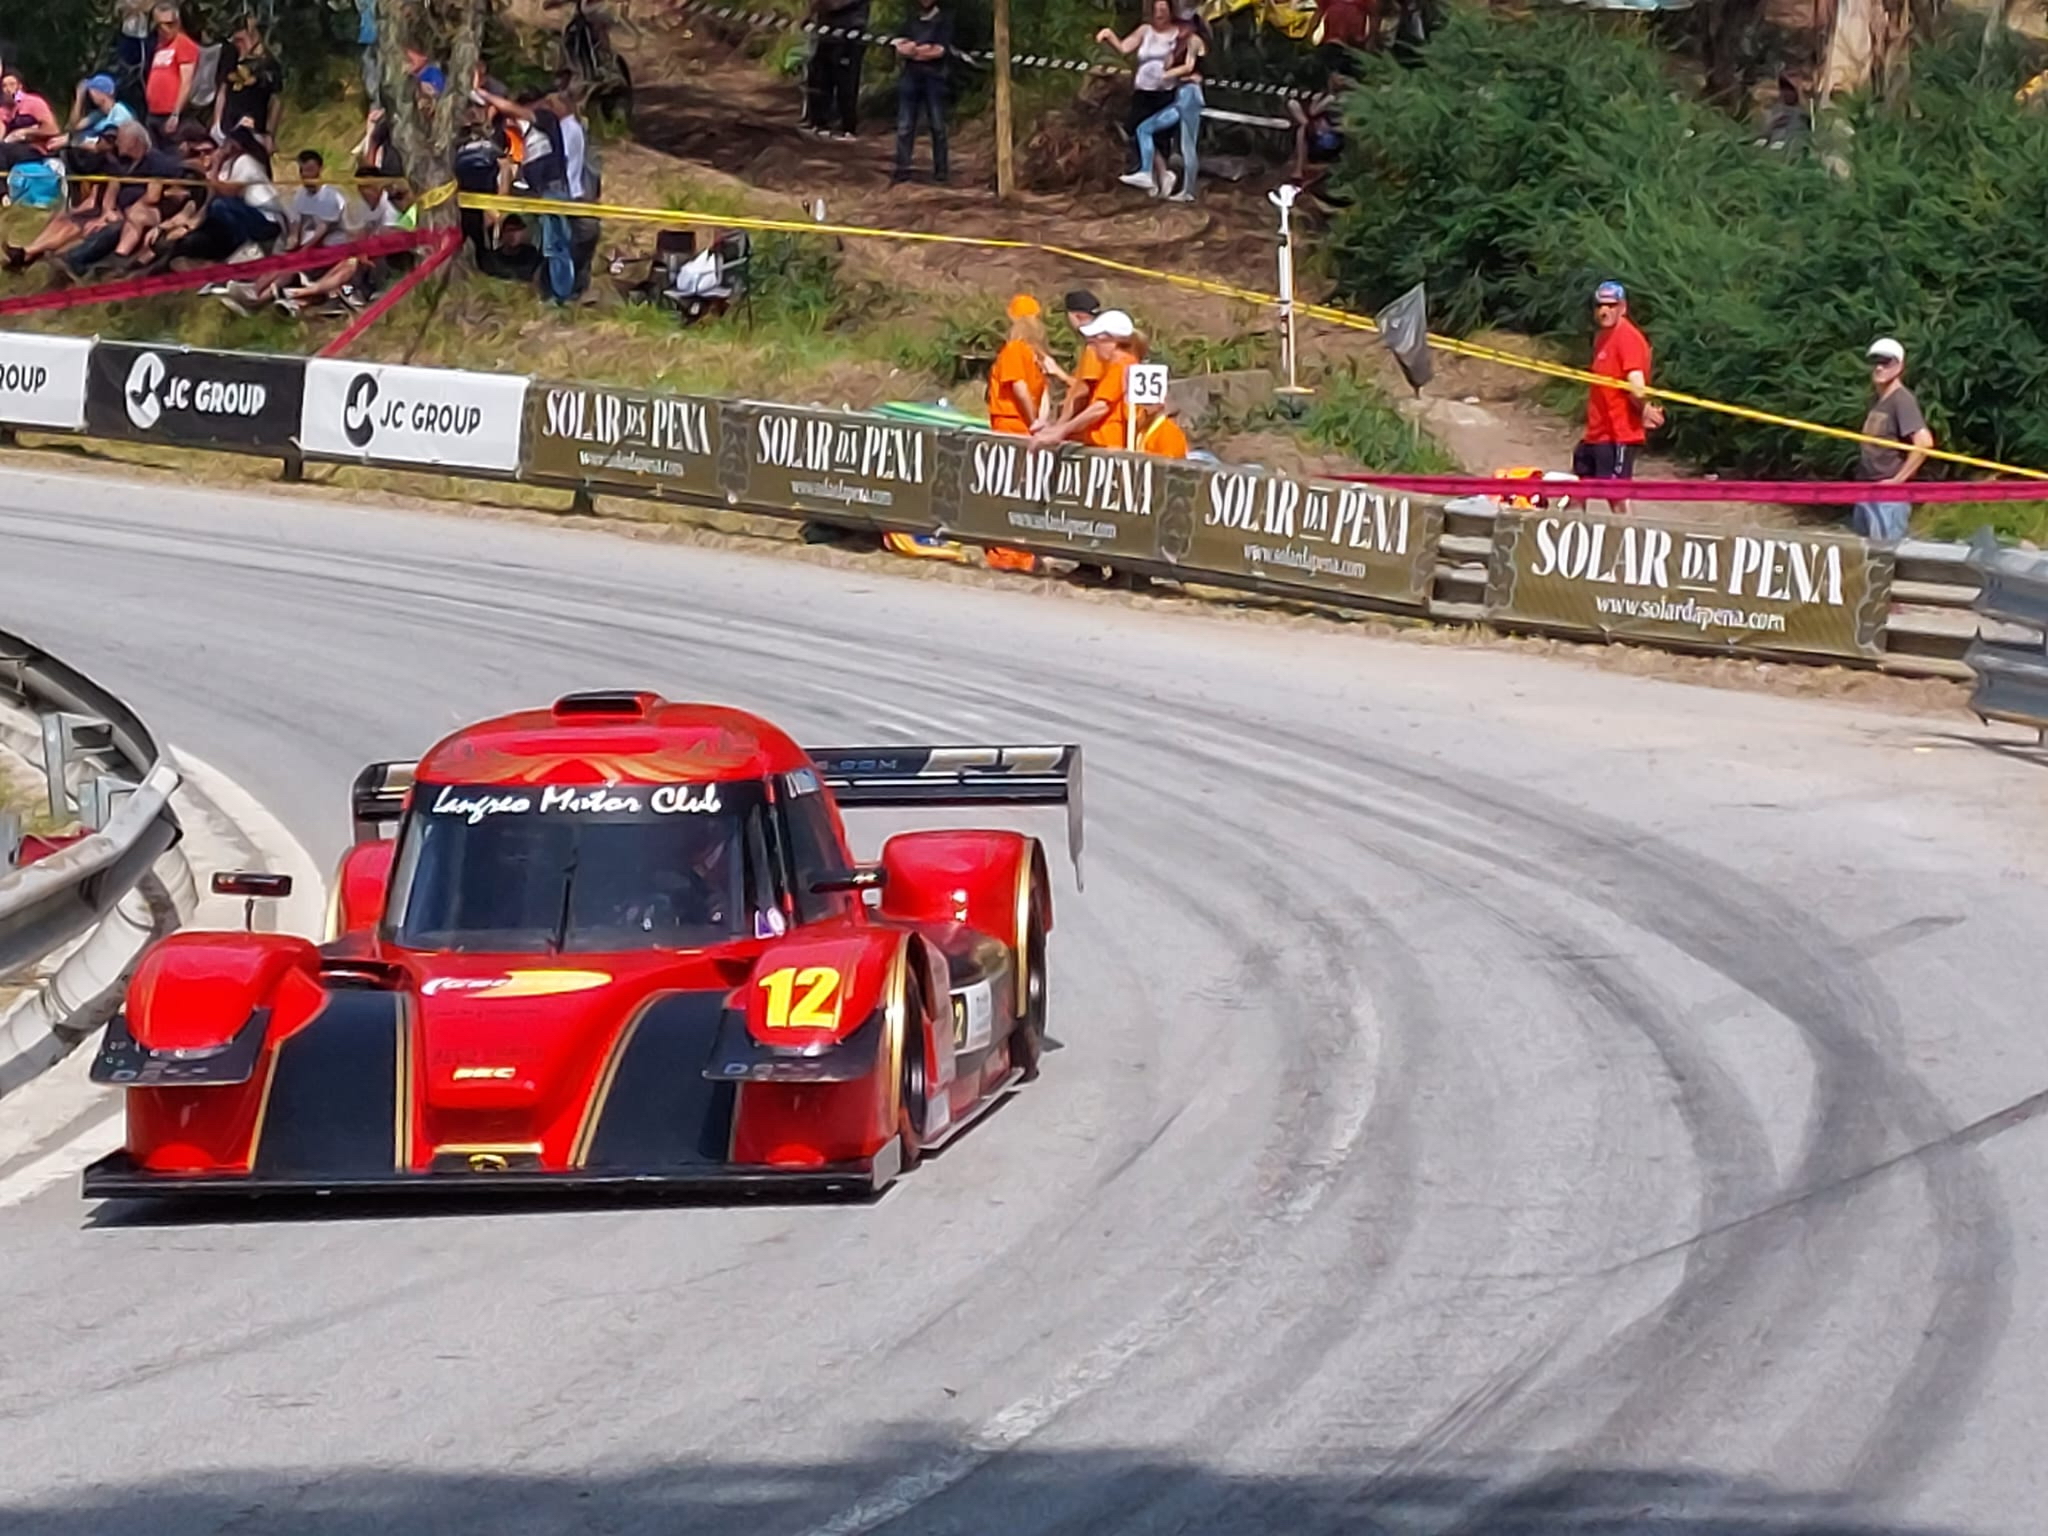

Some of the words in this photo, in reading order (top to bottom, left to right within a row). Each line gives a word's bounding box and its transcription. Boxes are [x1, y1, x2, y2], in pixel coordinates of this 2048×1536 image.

[163, 376, 192, 409] JC
[195, 380, 266, 416] GROUP
[1133, 371, 1163, 397] 35
[379, 400, 406, 429] JC
[411, 402, 481, 435] GROUP
[542, 389, 621, 447] SOLAR
[651, 398, 712, 456] PENA
[756, 414, 833, 472] SOLAR
[861, 423, 923, 484] PENA
[969, 440, 1054, 503] SOLAR
[1056, 460, 1081, 497] DA
[1084, 456, 1152, 515] PENA
[1204, 472, 1300, 538] SOLAR
[1302, 492, 1329, 532] DA
[1331, 488, 1410, 555] PENA
[1531, 518, 1672, 588] SOLAR
[1680, 540, 1718, 582] DA
[1727, 535, 1844, 606] PENA
[1595, 594, 1787, 633] www.solardapena.com
[431, 786, 531, 825] Langreo
[540, 786, 643, 814] Motor
[651, 783, 723, 814] Club
[758, 966, 842, 1031] 12
